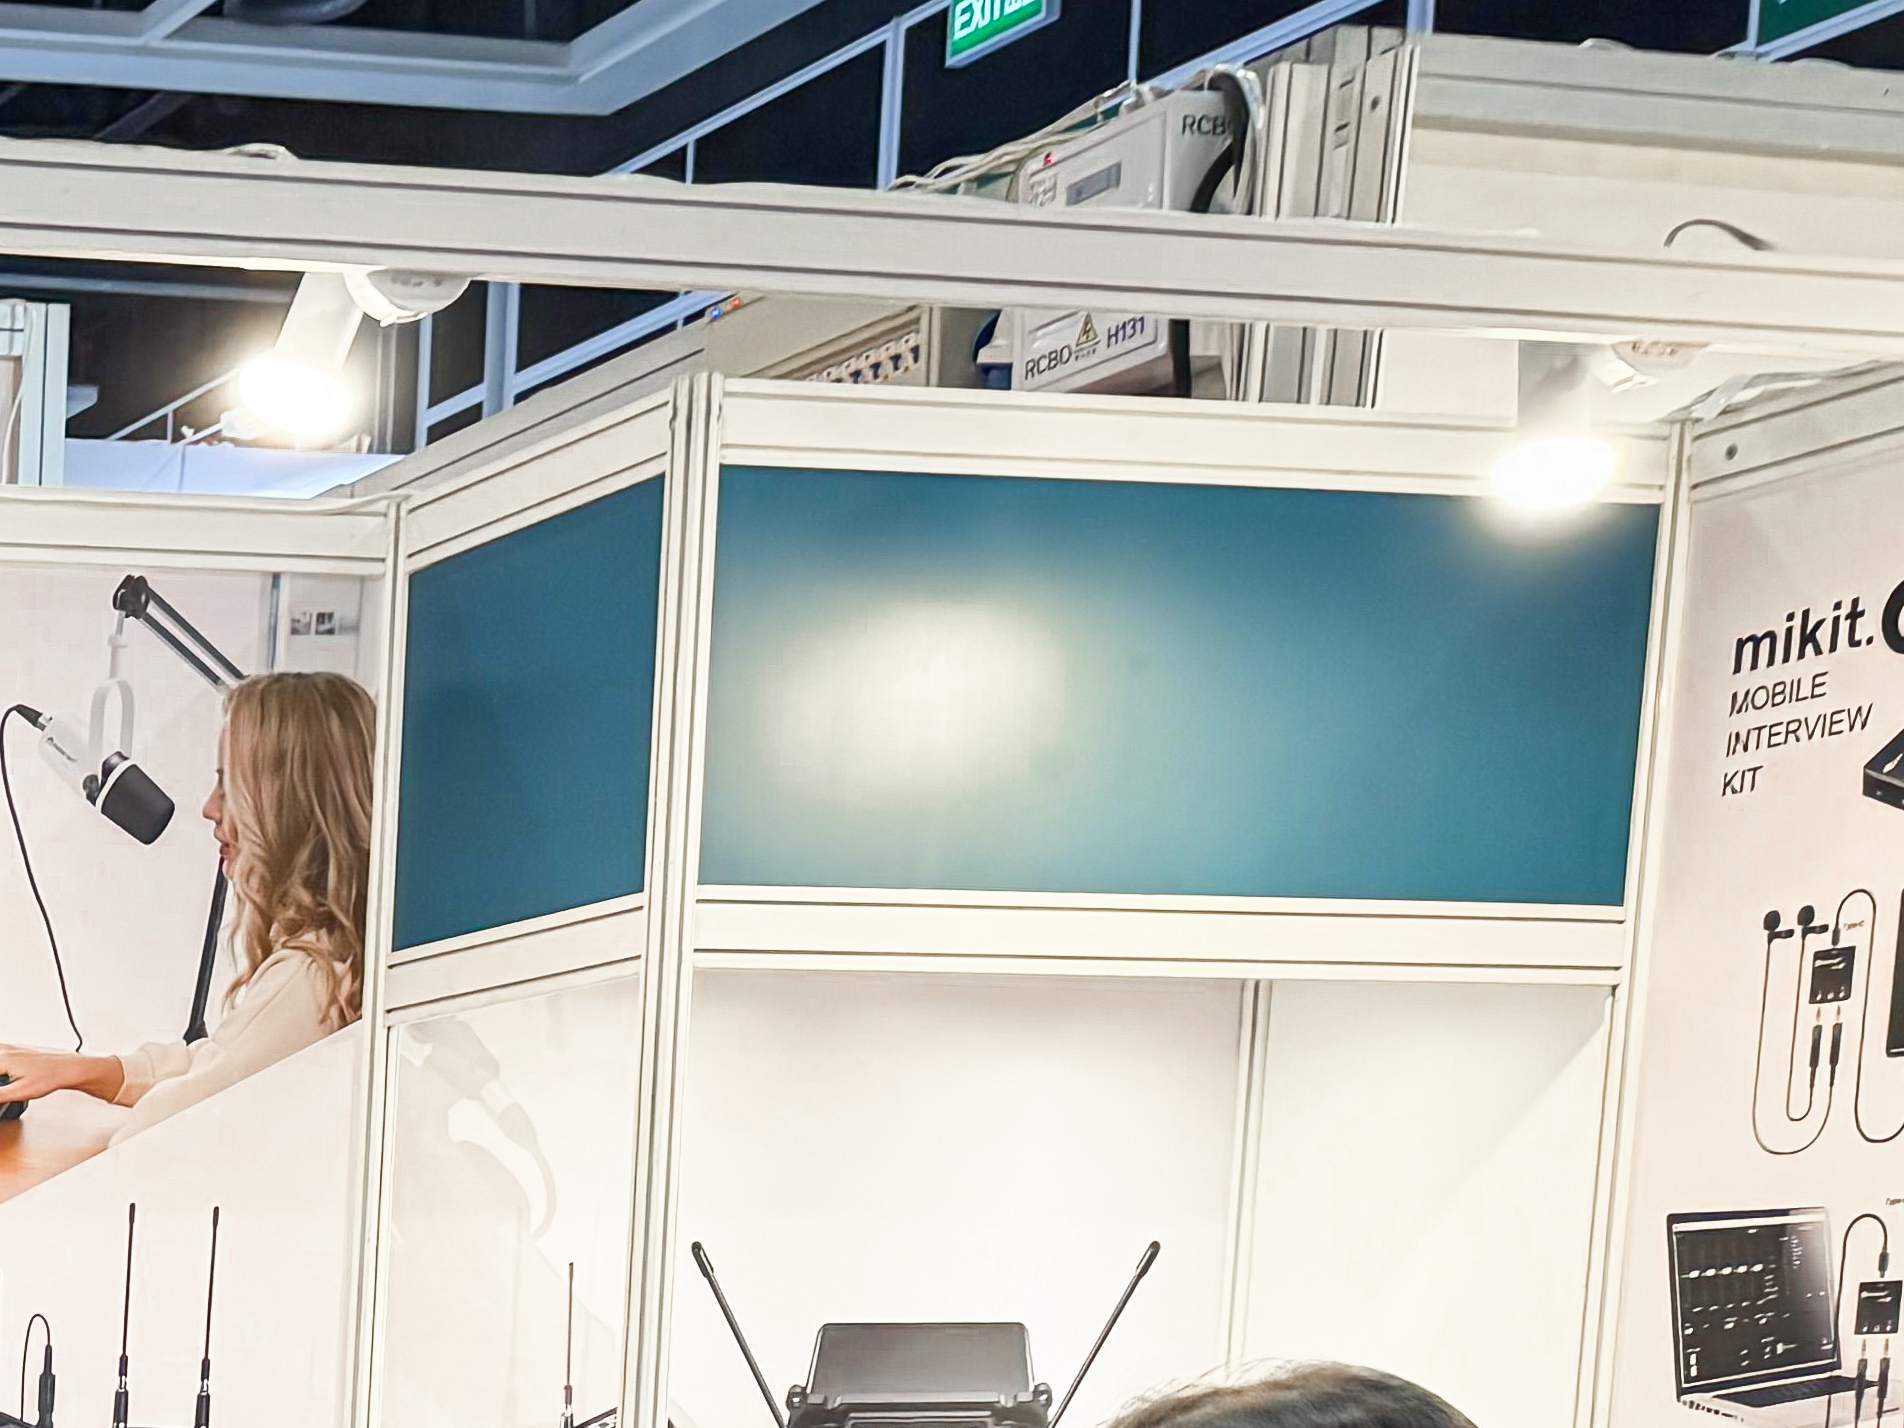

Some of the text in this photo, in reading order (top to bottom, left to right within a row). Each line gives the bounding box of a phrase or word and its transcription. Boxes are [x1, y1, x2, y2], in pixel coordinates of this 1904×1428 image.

[1024, 344, 1073, 381] RCBO
[1729, 671, 1829, 717] MOBILE
[1726, 702, 1874, 758] INTERVIEW
[1721, 765, 1764, 797] KIT
